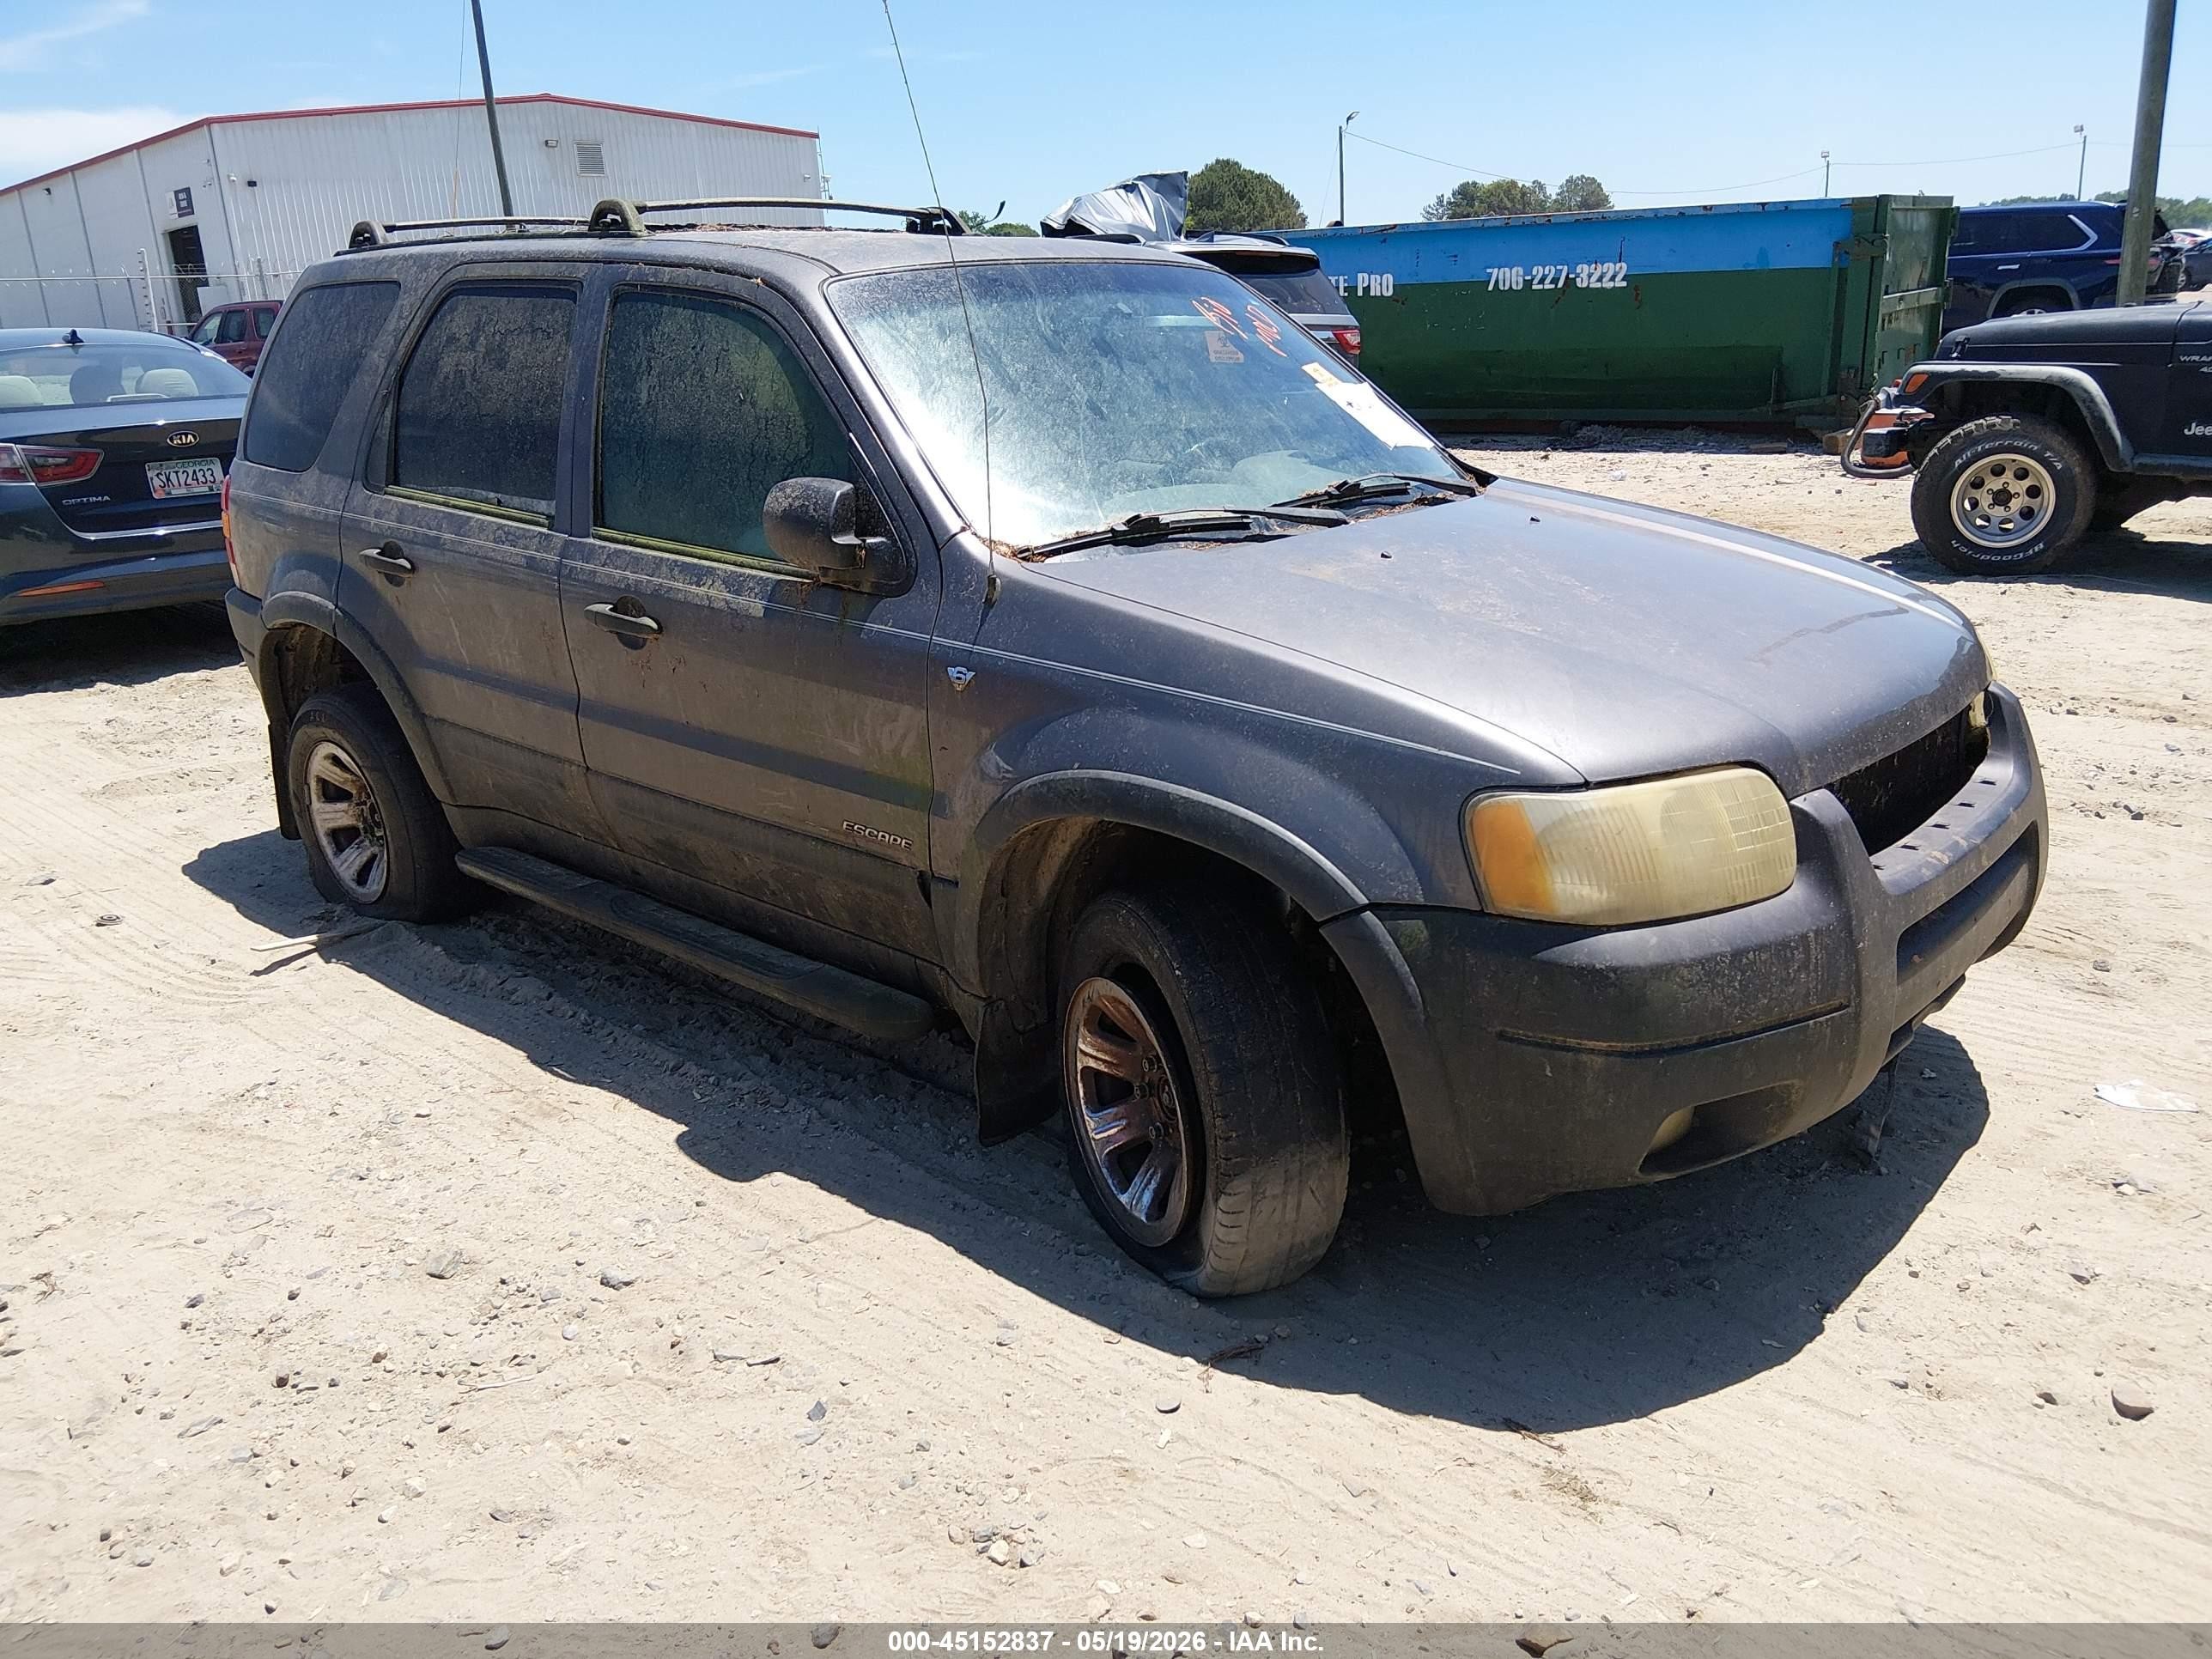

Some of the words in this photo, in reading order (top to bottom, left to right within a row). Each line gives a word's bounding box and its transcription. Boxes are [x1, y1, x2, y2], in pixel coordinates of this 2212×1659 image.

[1357, 272, 1394, 296] PRO
[1486, 262, 1628, 291] 706-227-3222
[173, 434, 195, 444] KIA
[175, 459, 216, 469] GEORGIA
[155, 468, 216, 489] SKT2433
[62, 495, 111, 505] OPTIMA
[842, 821, 914, 851] ESCAPE
